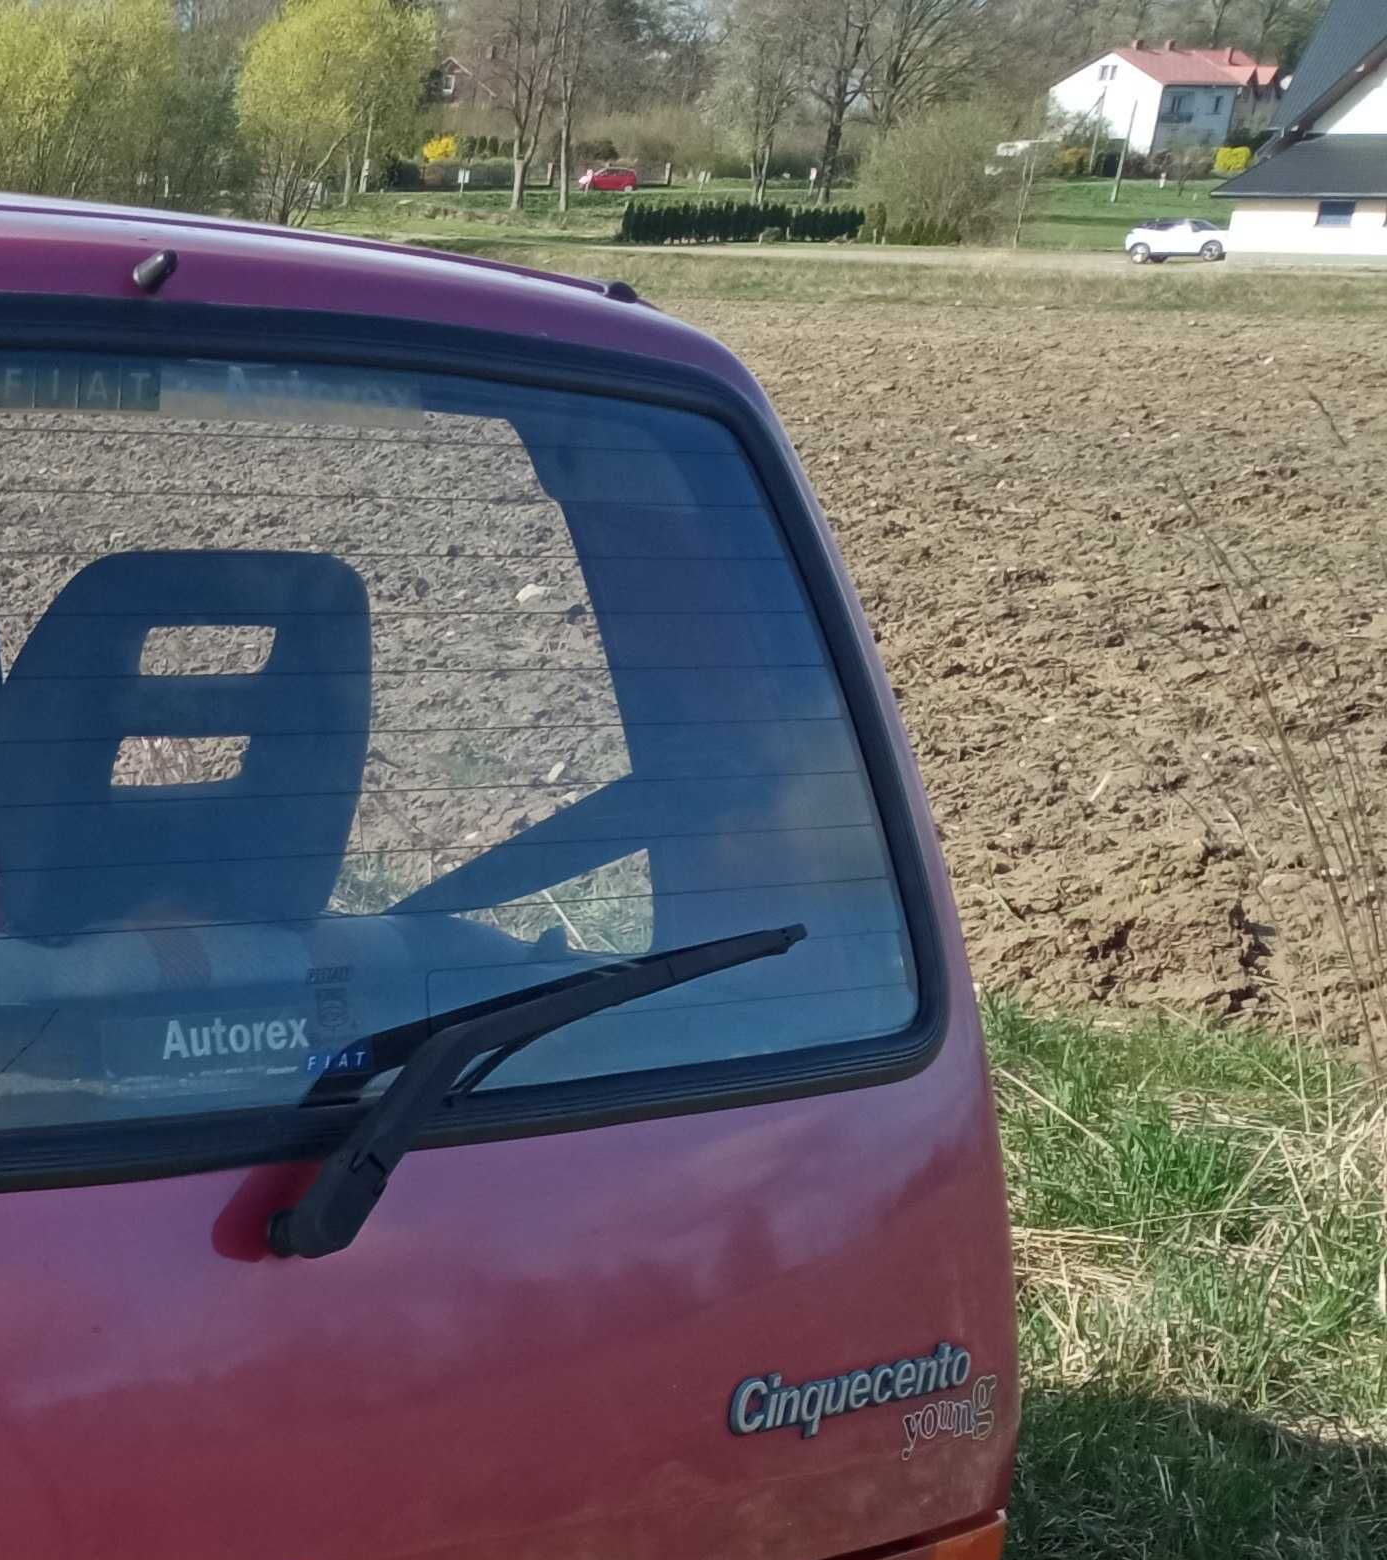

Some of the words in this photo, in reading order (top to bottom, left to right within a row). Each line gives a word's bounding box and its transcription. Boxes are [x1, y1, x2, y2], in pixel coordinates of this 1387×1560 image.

[3, 367, 152, 402] FIAT
[163, 1017, 310, 1060] Autorex
[307, 1051, 366, 1071] FIAT
[730, 1341, 971, 1438] Cinquecento
[901, 1374, 997, 1460] young
